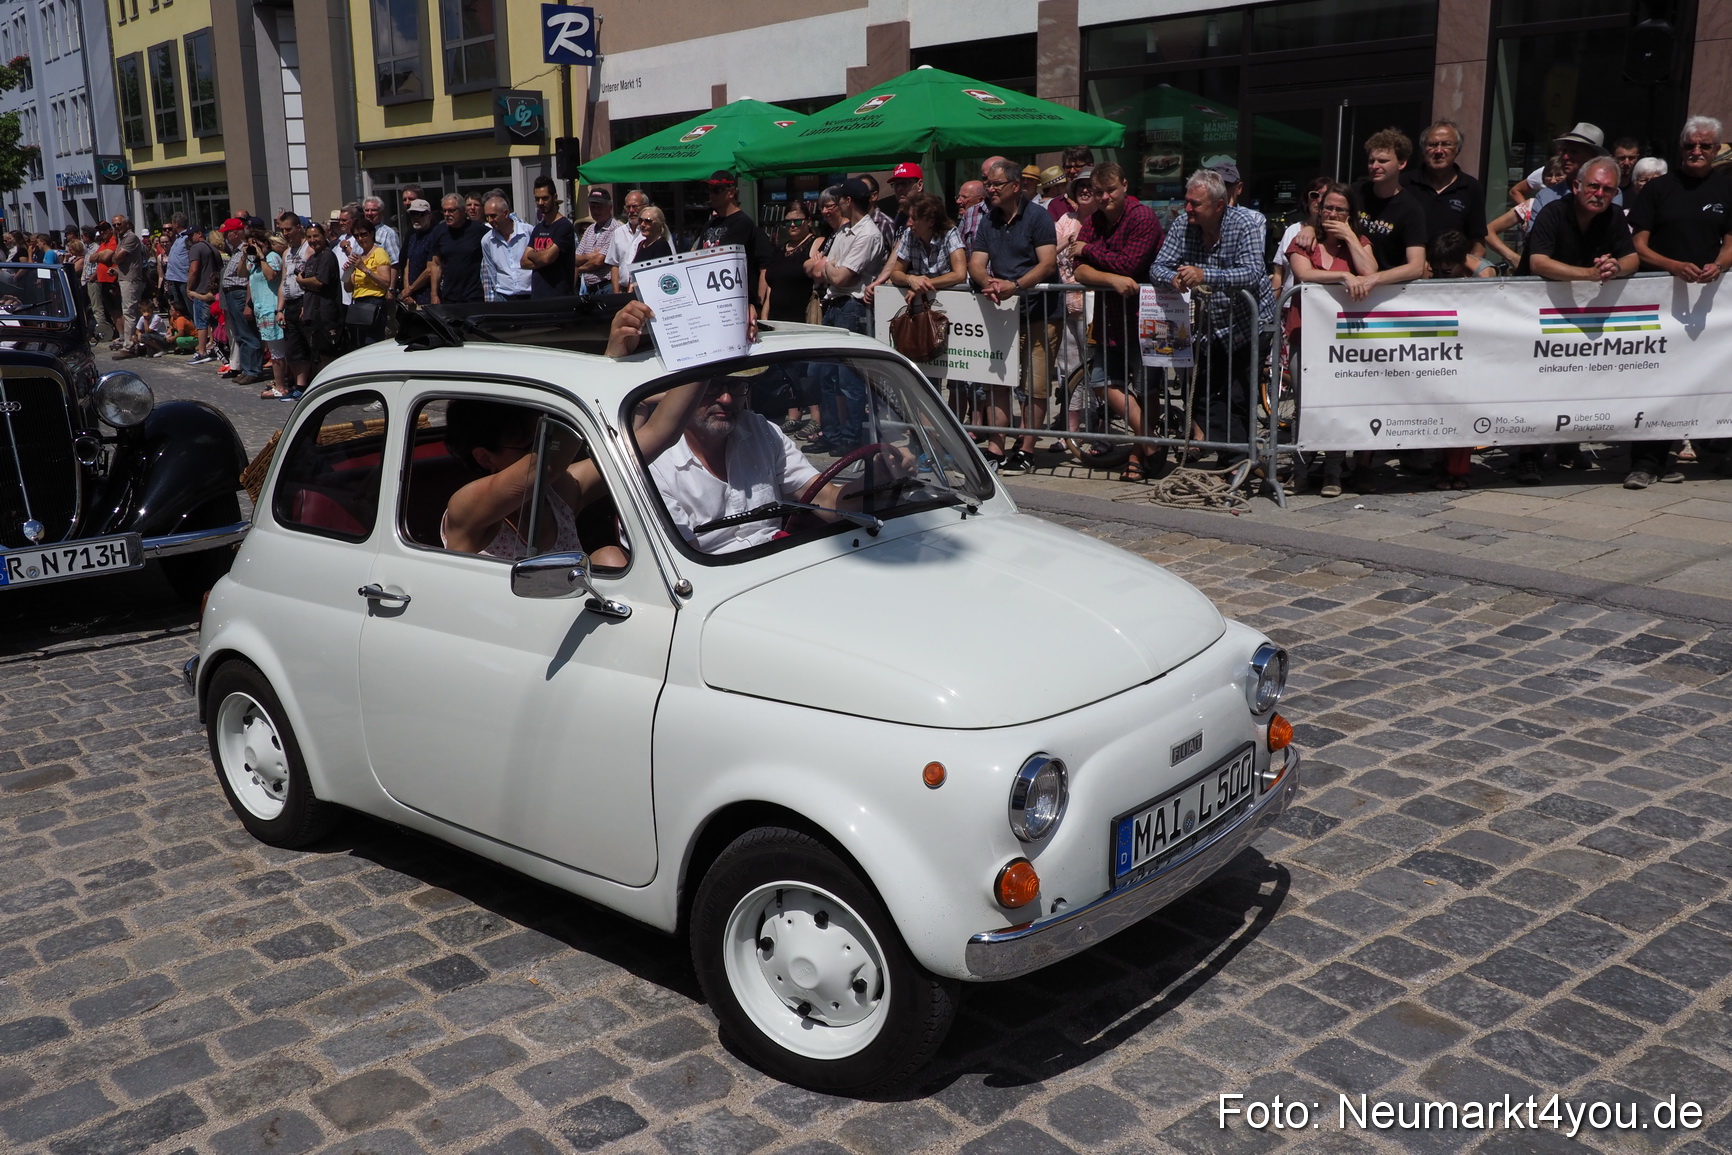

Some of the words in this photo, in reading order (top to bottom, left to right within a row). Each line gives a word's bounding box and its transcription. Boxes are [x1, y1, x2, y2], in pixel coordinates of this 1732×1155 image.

[601, 83, 619, 93] Unterer
[620, 79, 635, 90] Markt
[636, 77, 642, 88] 15
[822, 114, 884, 126] Neumarkter
[799, 121, 884, 137] Lammsbräu
[631, 150, 701, 160] Lammsbräu
[706, 267, 743, 292] 464
[1329, 342, 1463, 363] NeuerMarkt
[1533, 336, 1667, 358] NeuerMarkt
[1335, 369, 1379, 378] einkaufen
[1384, 369, 1410, 377] leben
[1416, 368, 1457, 378] genießen
[1539, 364, 1583, 373] einkaufen
[1589, 363, 1613, 371] leben
[1618, 361, 1659, 372] genießen
[1386, 418, 1438, 426] Dammstraße
[1575, 413, 1593, 421] über
[1595, 413, 1611, 421] 500
[1521, 425, 1536, 433] Uhr
[1573, 423, 1615, 432] Parkplätze
[1645, 419, 1699, 428] NM-Neumarkt
[1386, 428, 1425, 437] Neumarkt
[1432, 427, 1440, 435] d.
[1442, 427, 1458, 435] OPf.
[7, 557, 25, 580] R
[1173, 735, 1201, 762] FIAT
[1134, 798, 1181, 862] MAI
[1199, 782, 1212, 823] L
[1217, 753, 1251, 810] 500
[1121, 852, 1128, 865] D
